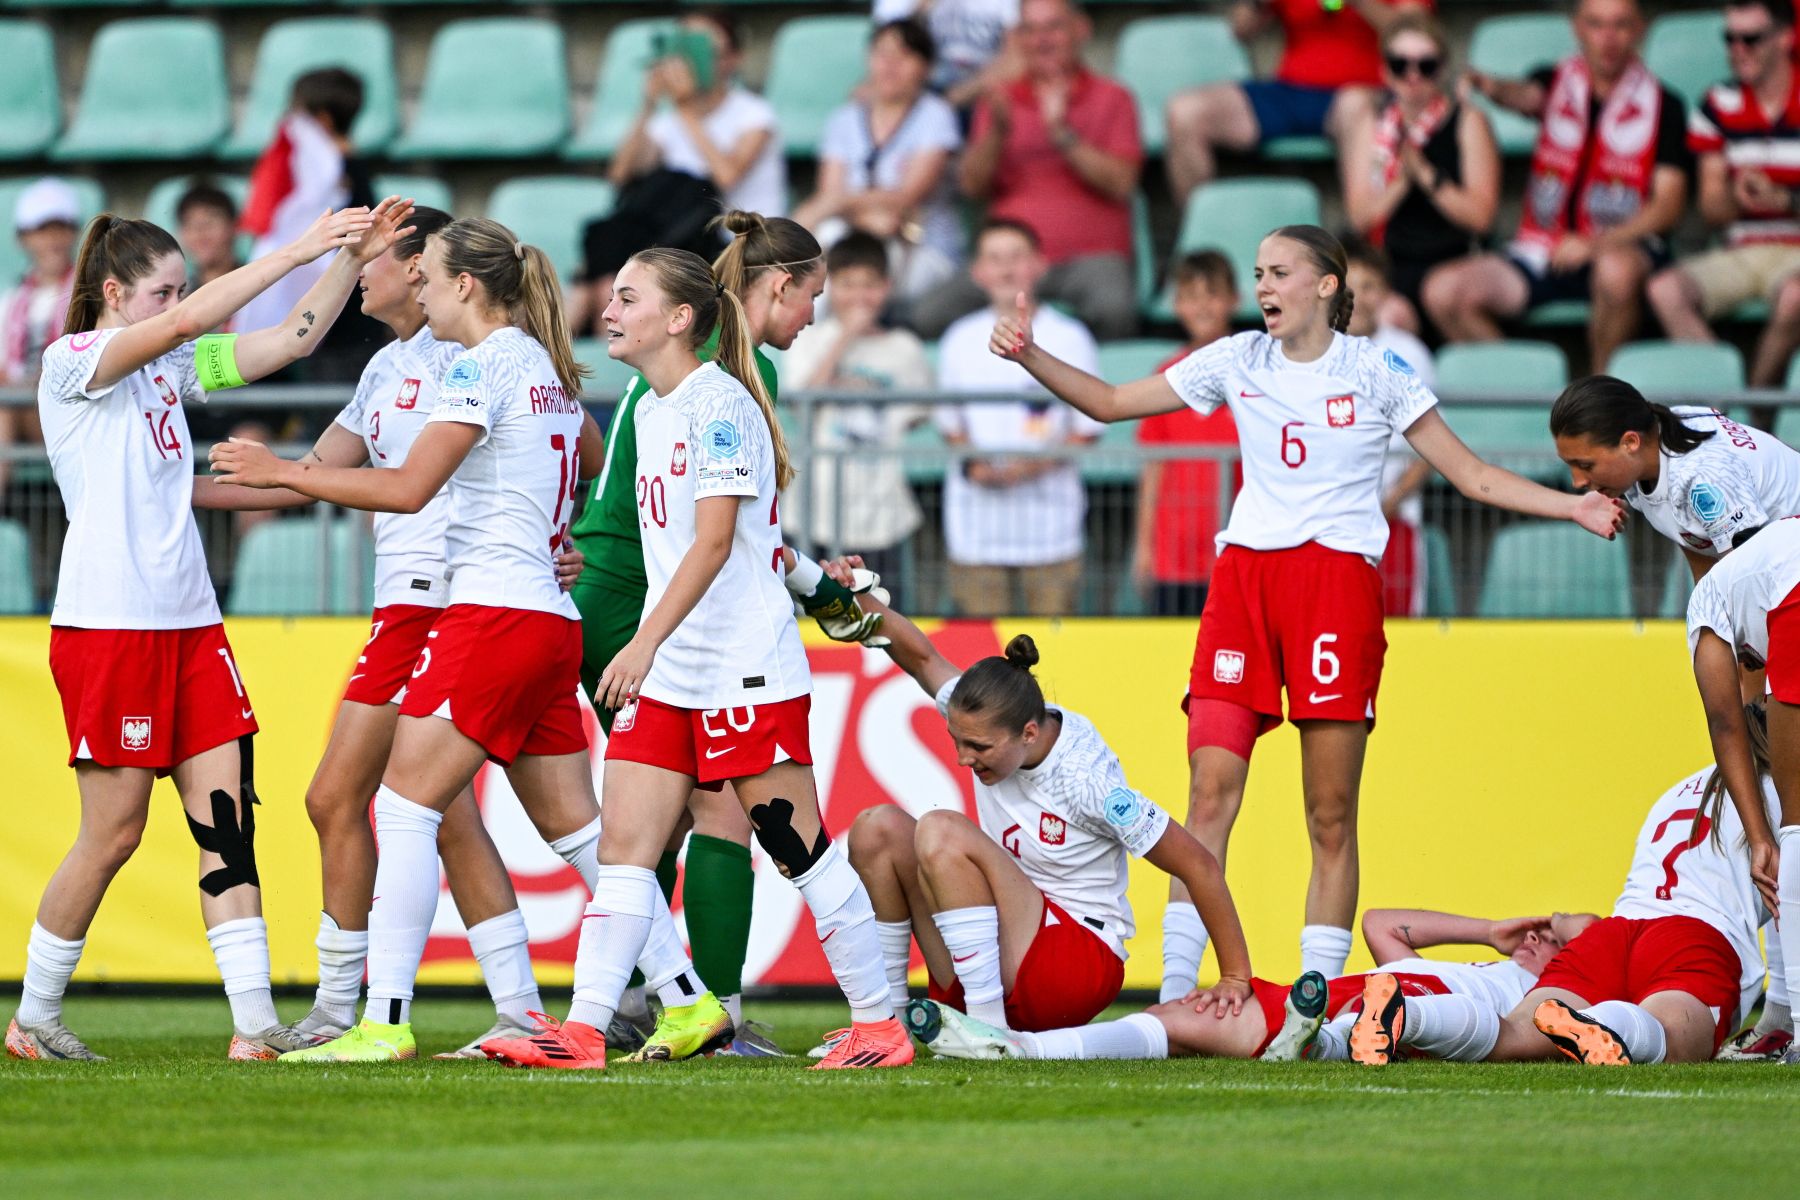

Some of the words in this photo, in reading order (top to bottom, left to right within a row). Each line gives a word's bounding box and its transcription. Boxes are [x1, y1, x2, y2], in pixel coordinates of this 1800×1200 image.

[210, 343, 223, 380] RESPECT
[529, 381, 579, 415] ARAŚNI
[144, 410, 183, 461] 14
[369, 410, 387, 461] 2
[1281, 421, 1306, 469] 6
[636, 474, 667, 529] 20
[217, 647, 244, 698] 1
[1312, 632, 1340, 685] 6
[1651, 807, 1713, 889] 7
